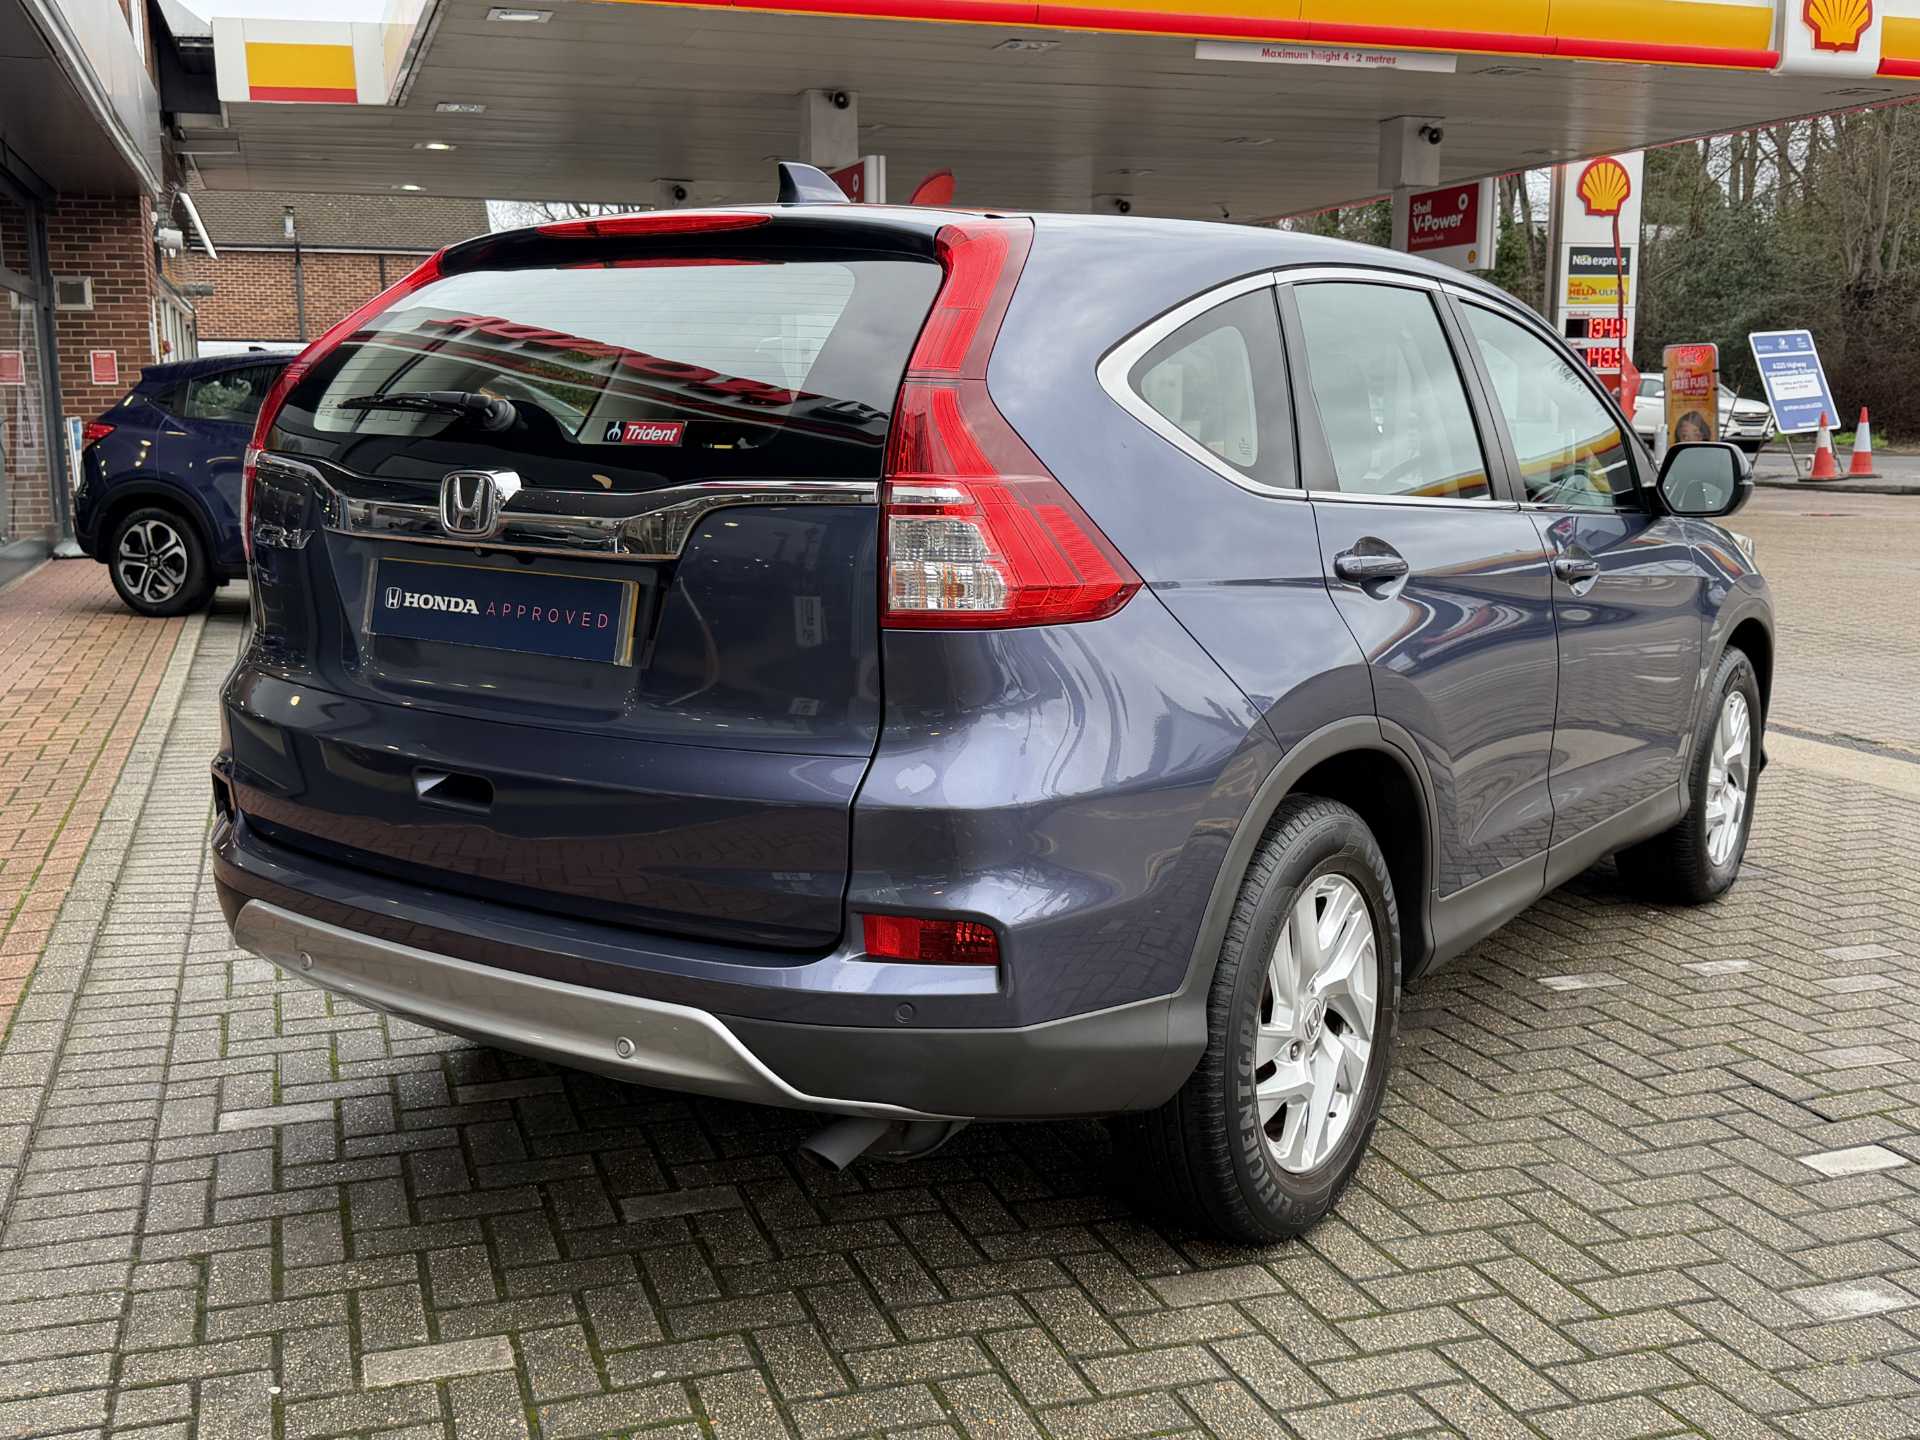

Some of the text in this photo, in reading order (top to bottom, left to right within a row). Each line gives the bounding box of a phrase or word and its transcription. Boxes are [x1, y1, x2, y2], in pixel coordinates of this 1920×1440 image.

[1261, 48, 1309, 60] Maximum
[1311, 50, 1341, 63] height
[1365, 54, 1397, 65] metres
[1412, 200, 1432, 215] Shell
[1592, 256, 1627, 268] expres
[626, 424, 678, 442] Trident
[403, 592, 480, 615] HONDA
[486, 600, 609, 629] APPROVED
